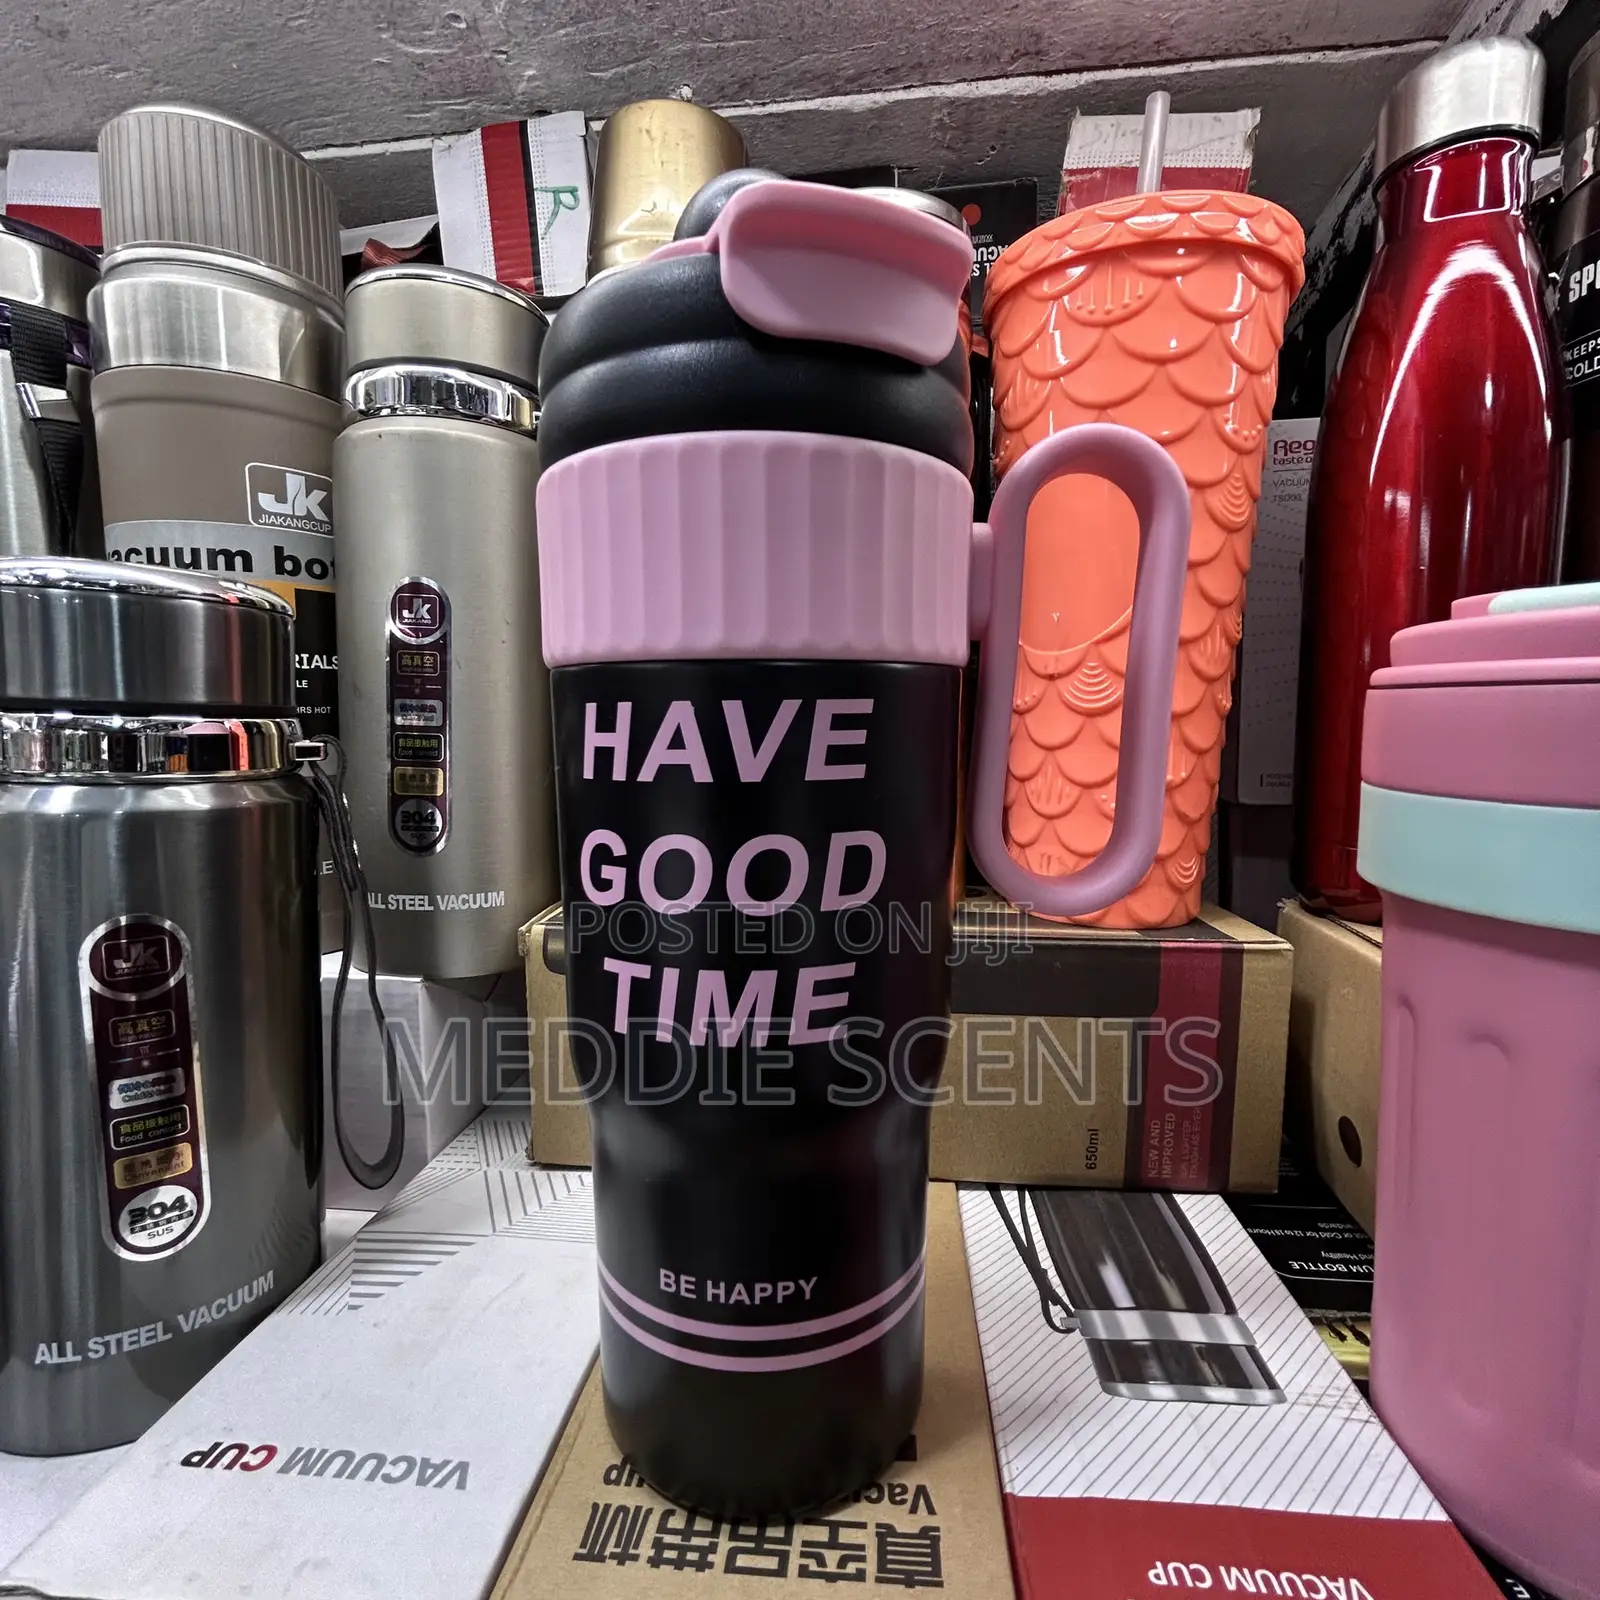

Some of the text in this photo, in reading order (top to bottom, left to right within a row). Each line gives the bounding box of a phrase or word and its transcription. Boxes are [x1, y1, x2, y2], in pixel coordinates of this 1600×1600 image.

[1273, 456, 1304, 466] taste
[258, 513, 332, 533] JIAKANGCUP
[107, 545, 335, 581] acuum bo
[314, 706, 332, 714] HOT
[582, 698, 875, 783] HAVE
[579, 828, 888, 917] GOOD
[388, 894, 434, 911] STEEL
[436, 890, 505, 911] VACUUM
[602, 956, 857, 1049] TIME
[119, 1132, 144, 1145] Food
[1084, 1128, 1099, 1170] 650ml
[1147, 1119, 1161, 1178] NEW AND
[1161, 1112, 1176, 1179] IMPROVED
[128, 1195, 191, 1226] 304
[147, 1226, 175, 1240] SUS
[1246, 1227, 1275, 1236] Hours
[1293, 1229, 1304, 1237] 12
[1306, 1230, 1318, 1238] for
[1318, 1230, 1342, 1240] Cold
[1288, 1260, 1348, 1272] BOTTLE
[1320, 1250, 1358, 1260] Healthy
[659, 1267, 819, 1306] BE HAPPY
[34, 1269, 275, 1365] ALL STEEL VACUUM
[180, 1440, 471, 1491] VACUUM CUP
[1147, 1560, 1376, 1600] VACUUM CUP
